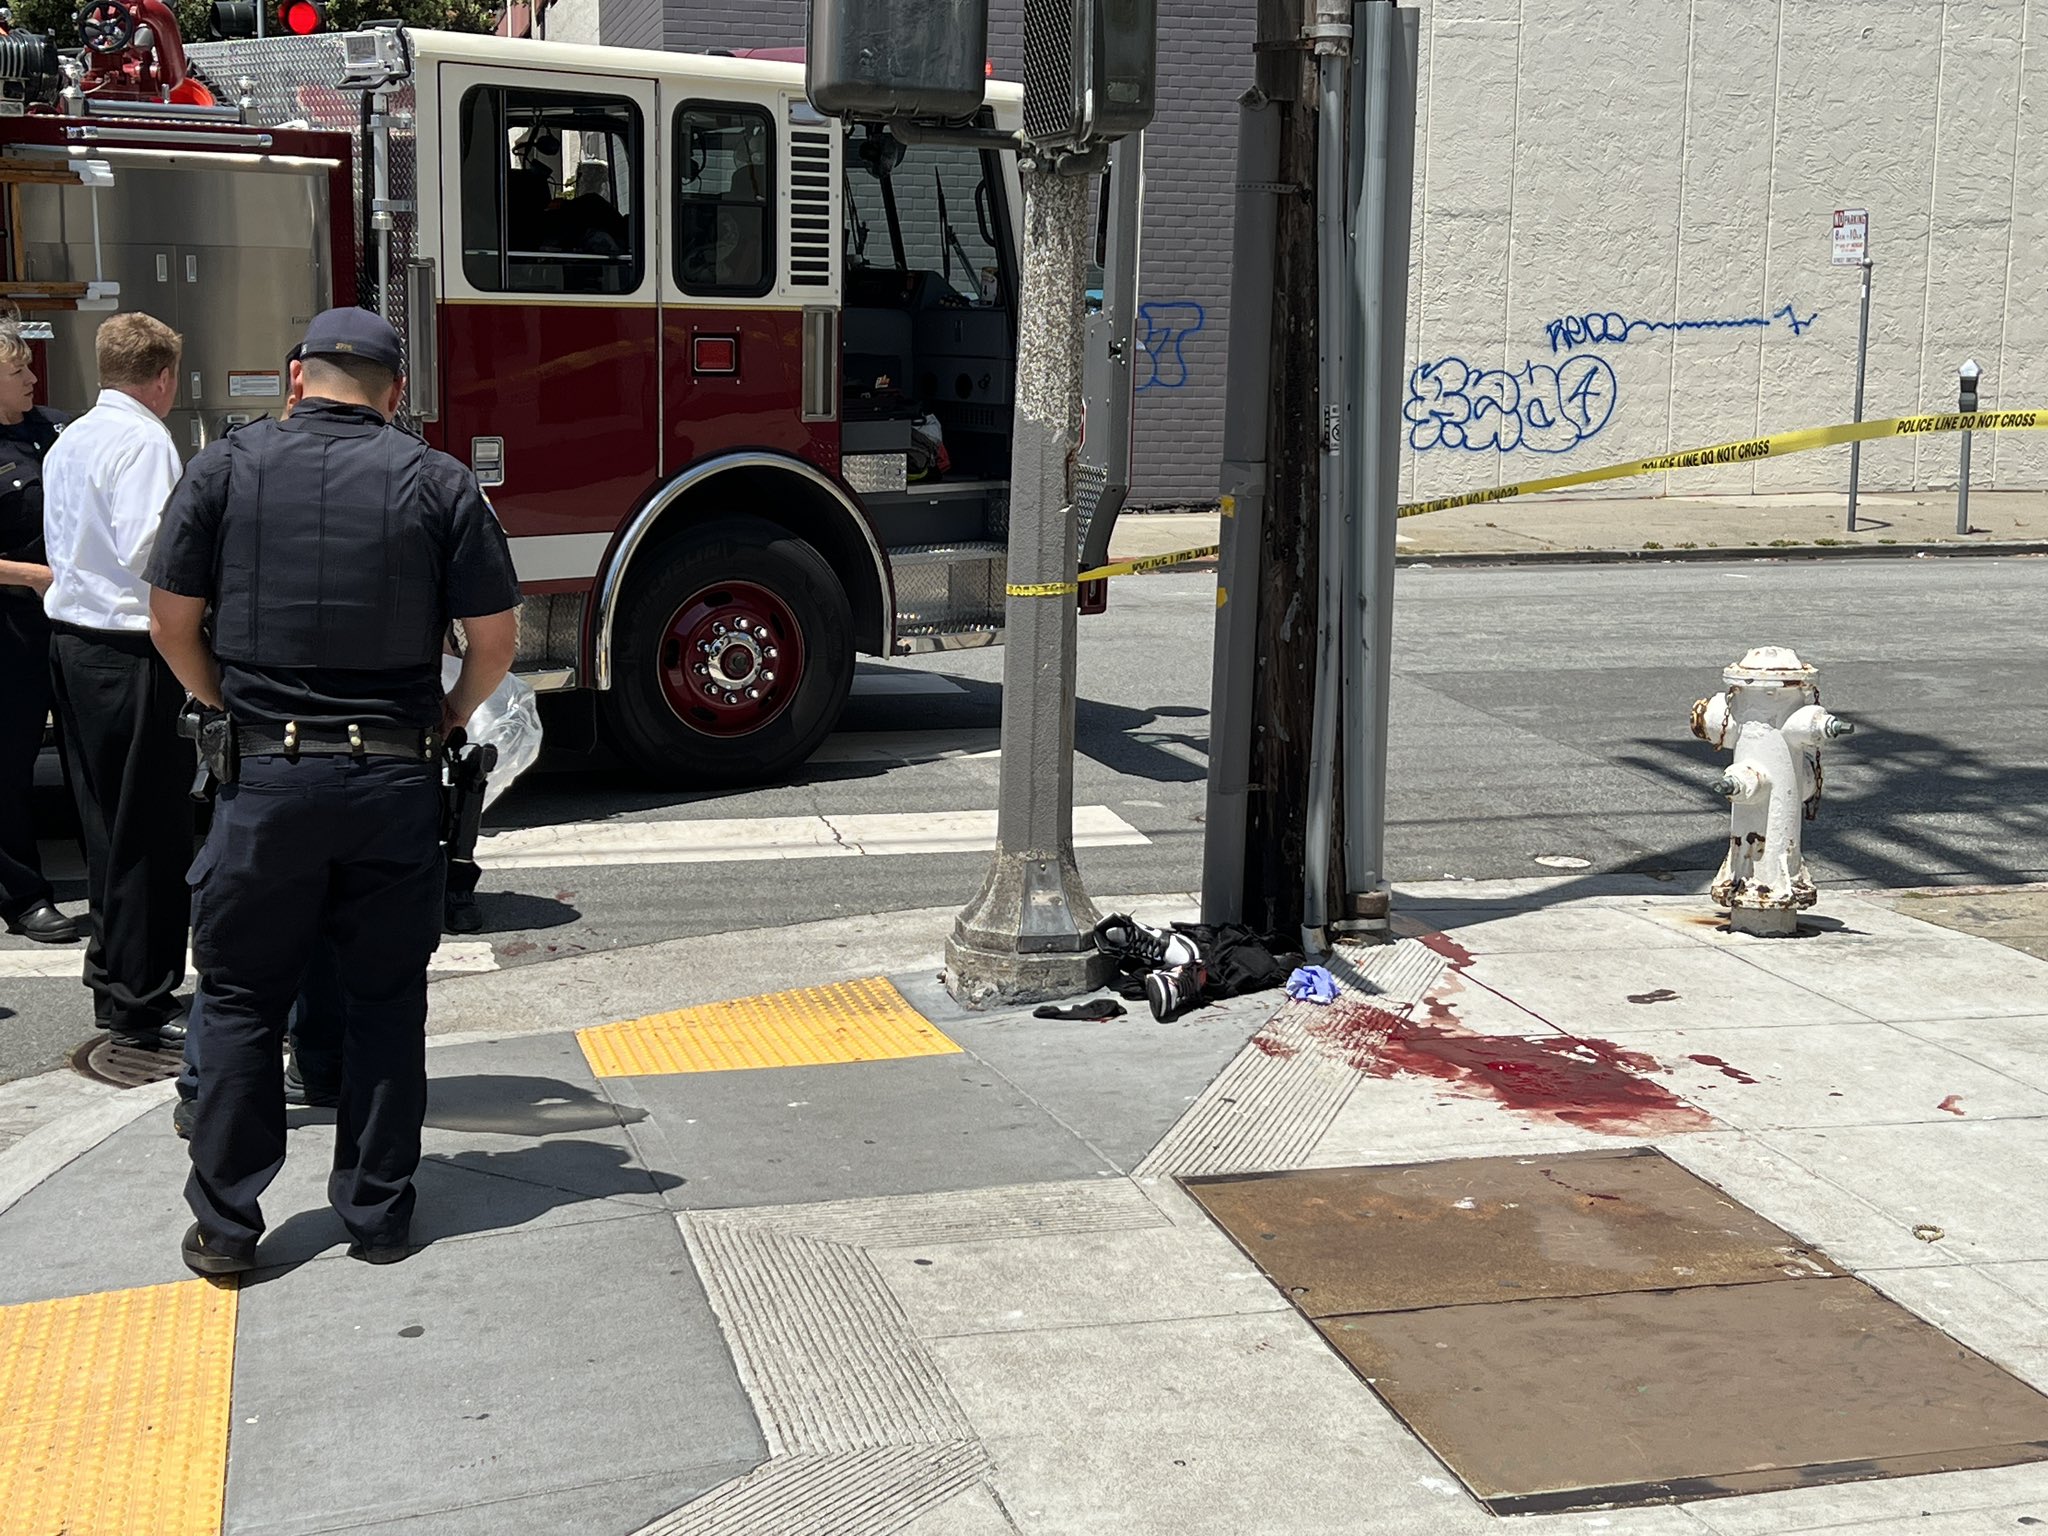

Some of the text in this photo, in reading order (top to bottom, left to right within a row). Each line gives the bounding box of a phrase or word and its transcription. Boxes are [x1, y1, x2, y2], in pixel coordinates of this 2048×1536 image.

[1834, 211, 1844, 227] NO
[1896, 413, 2037, 434] POLICE LINE DO NOT CROSS
[1677, 453, 1699, 467] LINE
[1700, 450, 1714, 465] DO
[1716, 445, 1738, 463] NOT
[1738, 439, 1770, 459] CROSS
